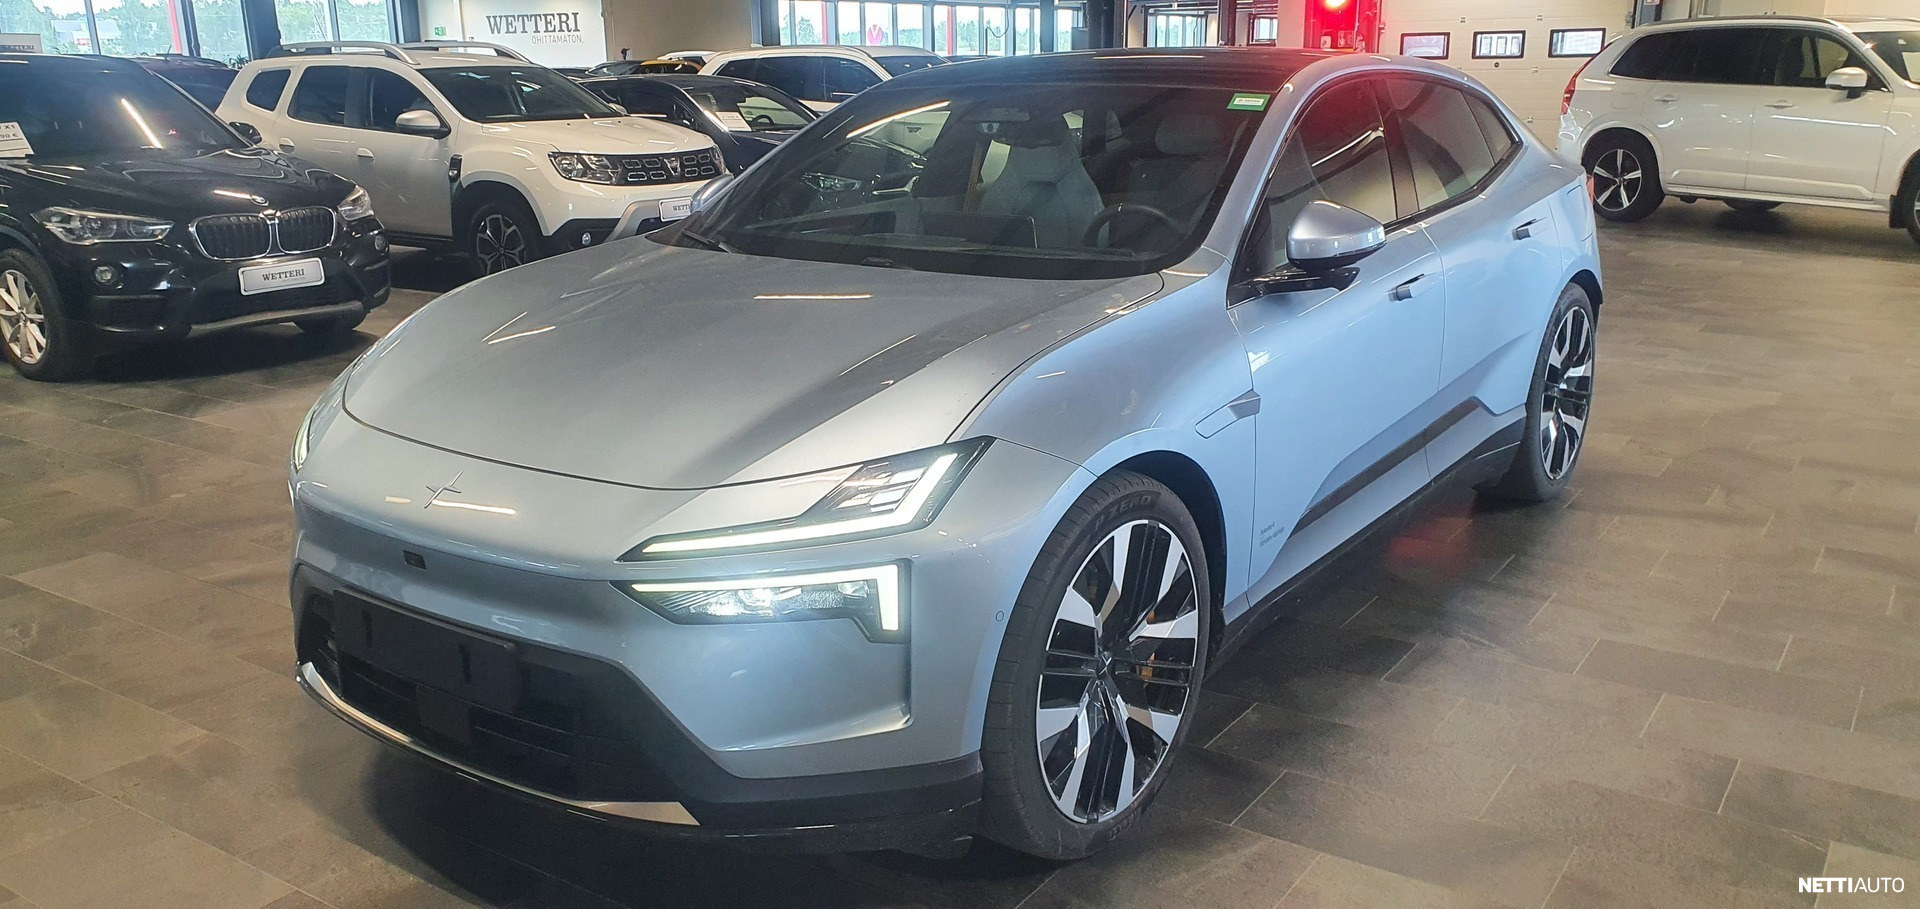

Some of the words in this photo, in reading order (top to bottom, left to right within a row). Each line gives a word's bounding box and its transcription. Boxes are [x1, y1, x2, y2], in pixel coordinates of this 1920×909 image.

[486, 12, 580, 34] WETTERI
[532, 34, 584, 44] OHITTAMATON.
[262, 268, 305, 281] WETTERI
